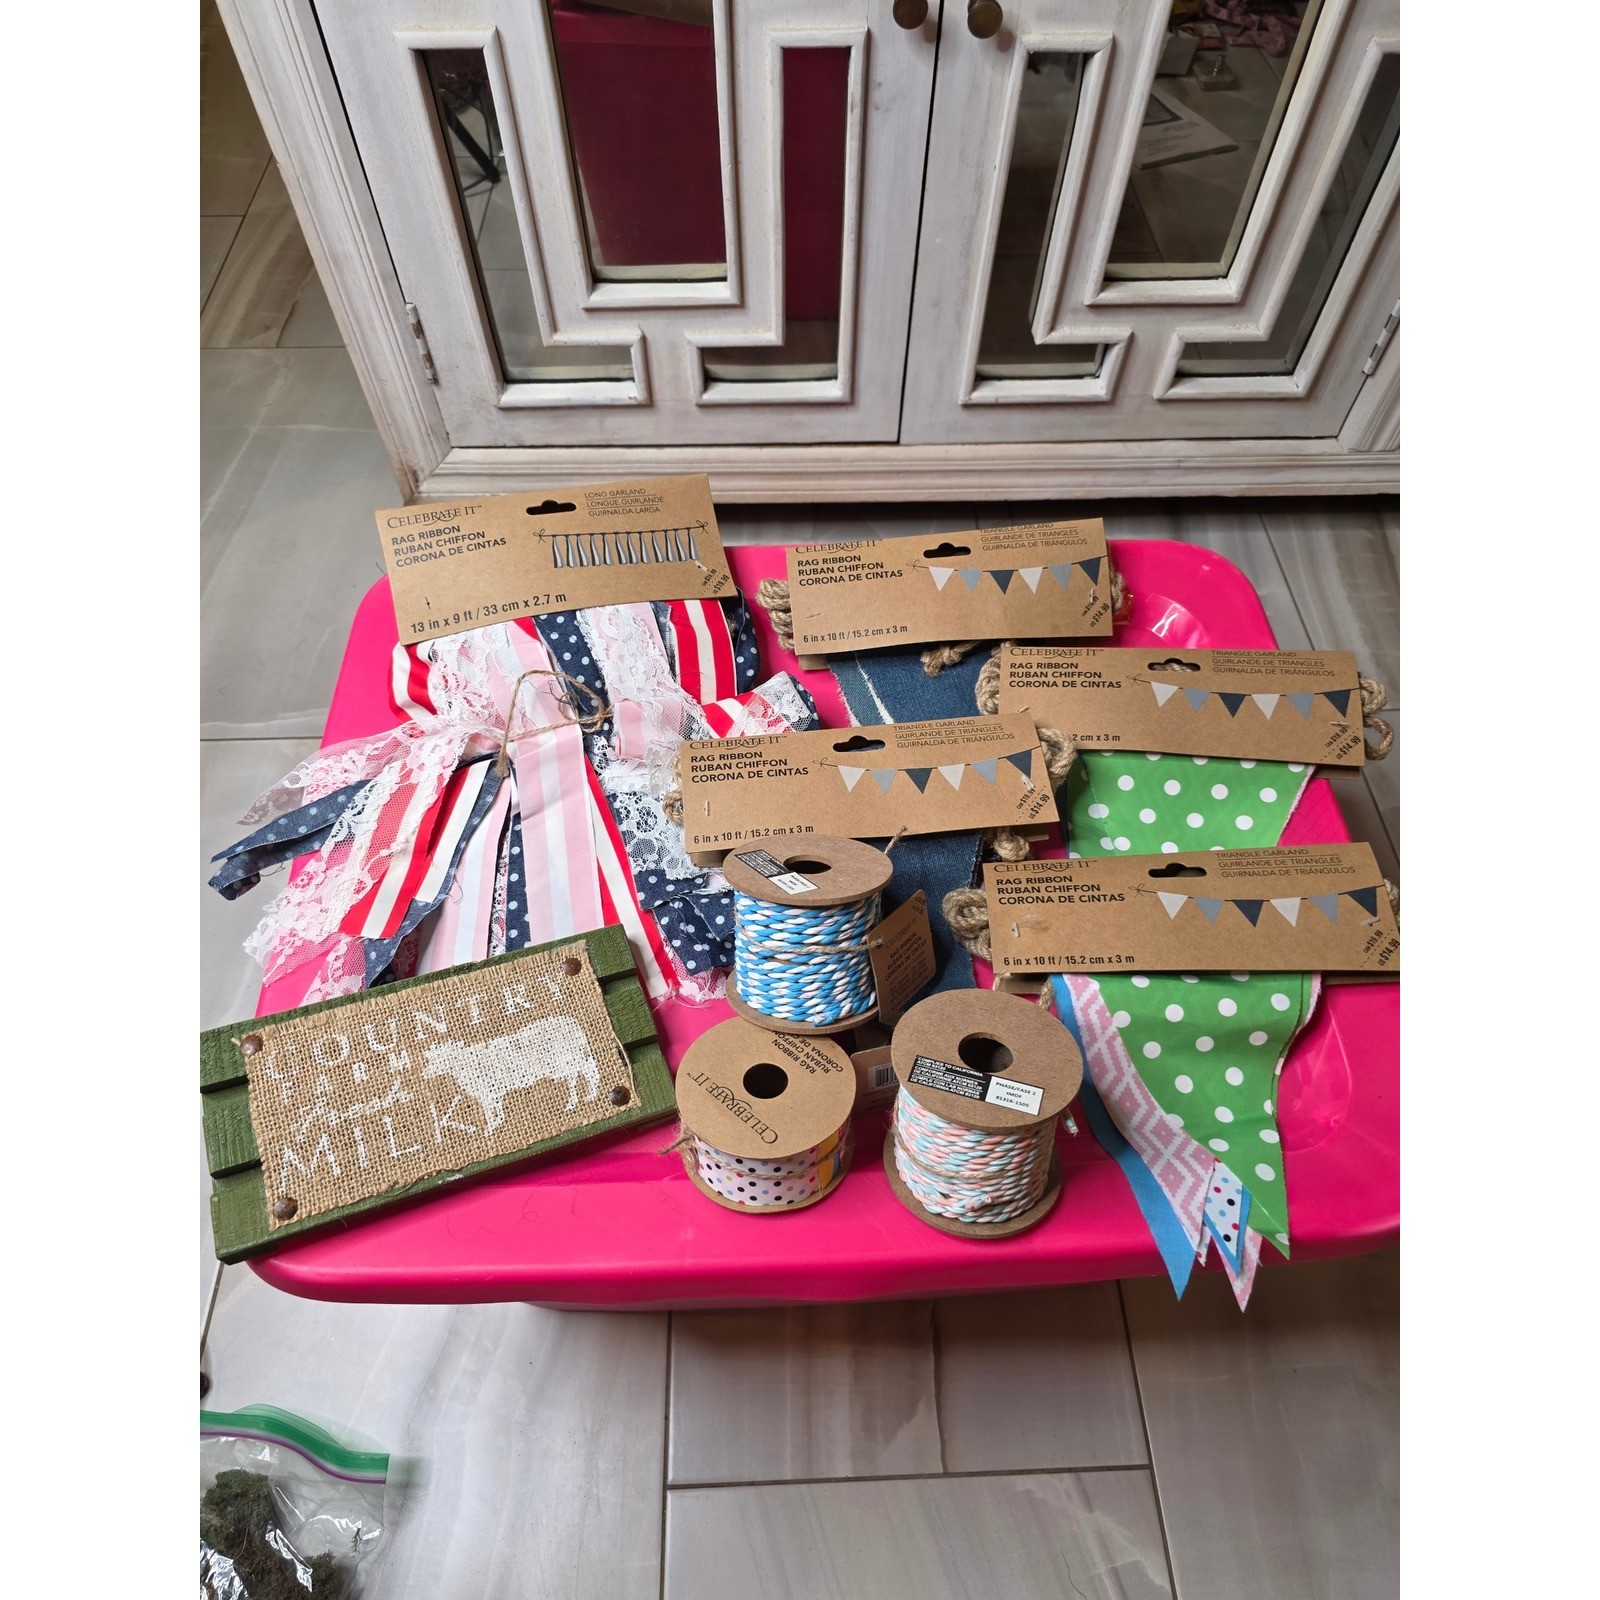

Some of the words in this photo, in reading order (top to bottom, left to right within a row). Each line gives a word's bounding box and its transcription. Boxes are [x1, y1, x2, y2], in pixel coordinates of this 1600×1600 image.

[610, 488, 646, 497] GARLAND
[587, 499, 619, 507] LONGUE
[621, 496, 664, 505] GUIRLANDE
[589, 508, 633, 516] GUIRNALDA
[635, 506, 660, 514] LARGA
[387, 508, 461, 528] CELEBRATE
[392, 534, 415, 545] RAG
[419, 525, 460, 539] RIBBON
[981, 533, 1023, 542] GUIRLANDE
[1039, 529, 1078, 537] TRIANGLES
[394, 542, 432, 556] RUBAN
[437, 531, 485, 547] CHIFFON
[796, 541, 863, 553] CELEBRATE
[983, 543, 1026, 551] GUIRNALDA
[396, 551, 445, 567] CORONA
[450, 546, 463, 555] DE
[467, 538, 506, 551] CINTAS
[798, 559, 819, 567] RAG
[822, 555, 861, 565] RIBBON
[799, 567, 834, 576] RUBAN
[838, 562, 884, 572] CHIFFON
[799, 575, 845, 586] CORONA
[849, 573, 862, 581] DE
[866, 570, 903, 580] CINTAS
[411, 622, 425, 633] 13
[429, 620, 439, 630] in
[443, 618, 450, 626] x
[453, 613, 460, 623] 9
[464, 610, 472, 621] ft
[484, 605, 498, 616] 33
[502, 601, 519, 612] cm
[524, 599, 529, 608] x
[533, 594, 550, 606] 2.7
[556, 593, 566, 602] m
[1093, 603, 1110, 622] $14.99
[828, 633, 836, 641] 10
[852, 629, 869, 638] 15.2
[1010, 648, 1082, 658] CELEBRATE
[1280, 668, 1335, 676] TRIÁNGULOS
[935, 720, 975, 728] GARLAND
[896, 730, 942, 739] GUIRLANDE
[959, 725, 1003, 735] TRIANGLES
[690, 738, 765, 750] CELEBRATE
[897, 739, 945, 748] GUIRNALDA
[1340, 736, 1361, 754] $14.99
[719, 752, 762, 760] RIBBON
[692, 763, 732, 772] RUBAN
[736, 759, 788, 769] CHIFFON
[692, 772, 744, 783] CORONA
[767, 767, 809, 777] CINTAS
[1031, 794, 1050, 814] $14.99
[694, 836, 699, 844] 6
[703, 835, 710, 843] in
[722, 832, 732, 841] 10
[735, 831, 741, 839] ft
[751, 829, 769, 838] 15.2
[994, 861, 1074, 873] CELEBRATE
[1219, 859, 1272, 868] GUIRLANDE
[1291, 857, 1342, 865] TRIANGLES
[1222, 870, 1276, 878] GUIRNALDA
[1279, 868, 1291, 876] DE
[1295, 867, 1355, 875] TRIÁNGULOS
[997, 878, 1022, 886] RAG
[1026, 876, 1072, 884] RIBBON
[999, 896, 1054, 905] CORONA
[1059, 895, 1075, 903] DE
[1079, 894, 1125, 902] CINTAS
[1379, 939, 1400, 960] $14.99
[1004, 957, 1009, 966] 6
[1013, 957, 1022, 965] in
[1034, 956, 1045, 965] 10
[1049, 956, 1056, 964] ft
[1065, 956, 1085, 964] 15.2
[1090, 956, 1104, 964] cm
[1116, 955, 1122, 963] 3
[266, 973, 564, 1081] COUNTRY
[799, 1039, 811, 1047] DE
[772, 1039, 800, 1061] RIBBON
[804, 1052, 831, 1074] RUBAN
[812, 1047, 843, 1072] CORONA
[800, 1060, 817, 1074] RAG
[706, 1082, 778, 1144] CELEBRATE
[280, 1096, 477, 1192] MILK
